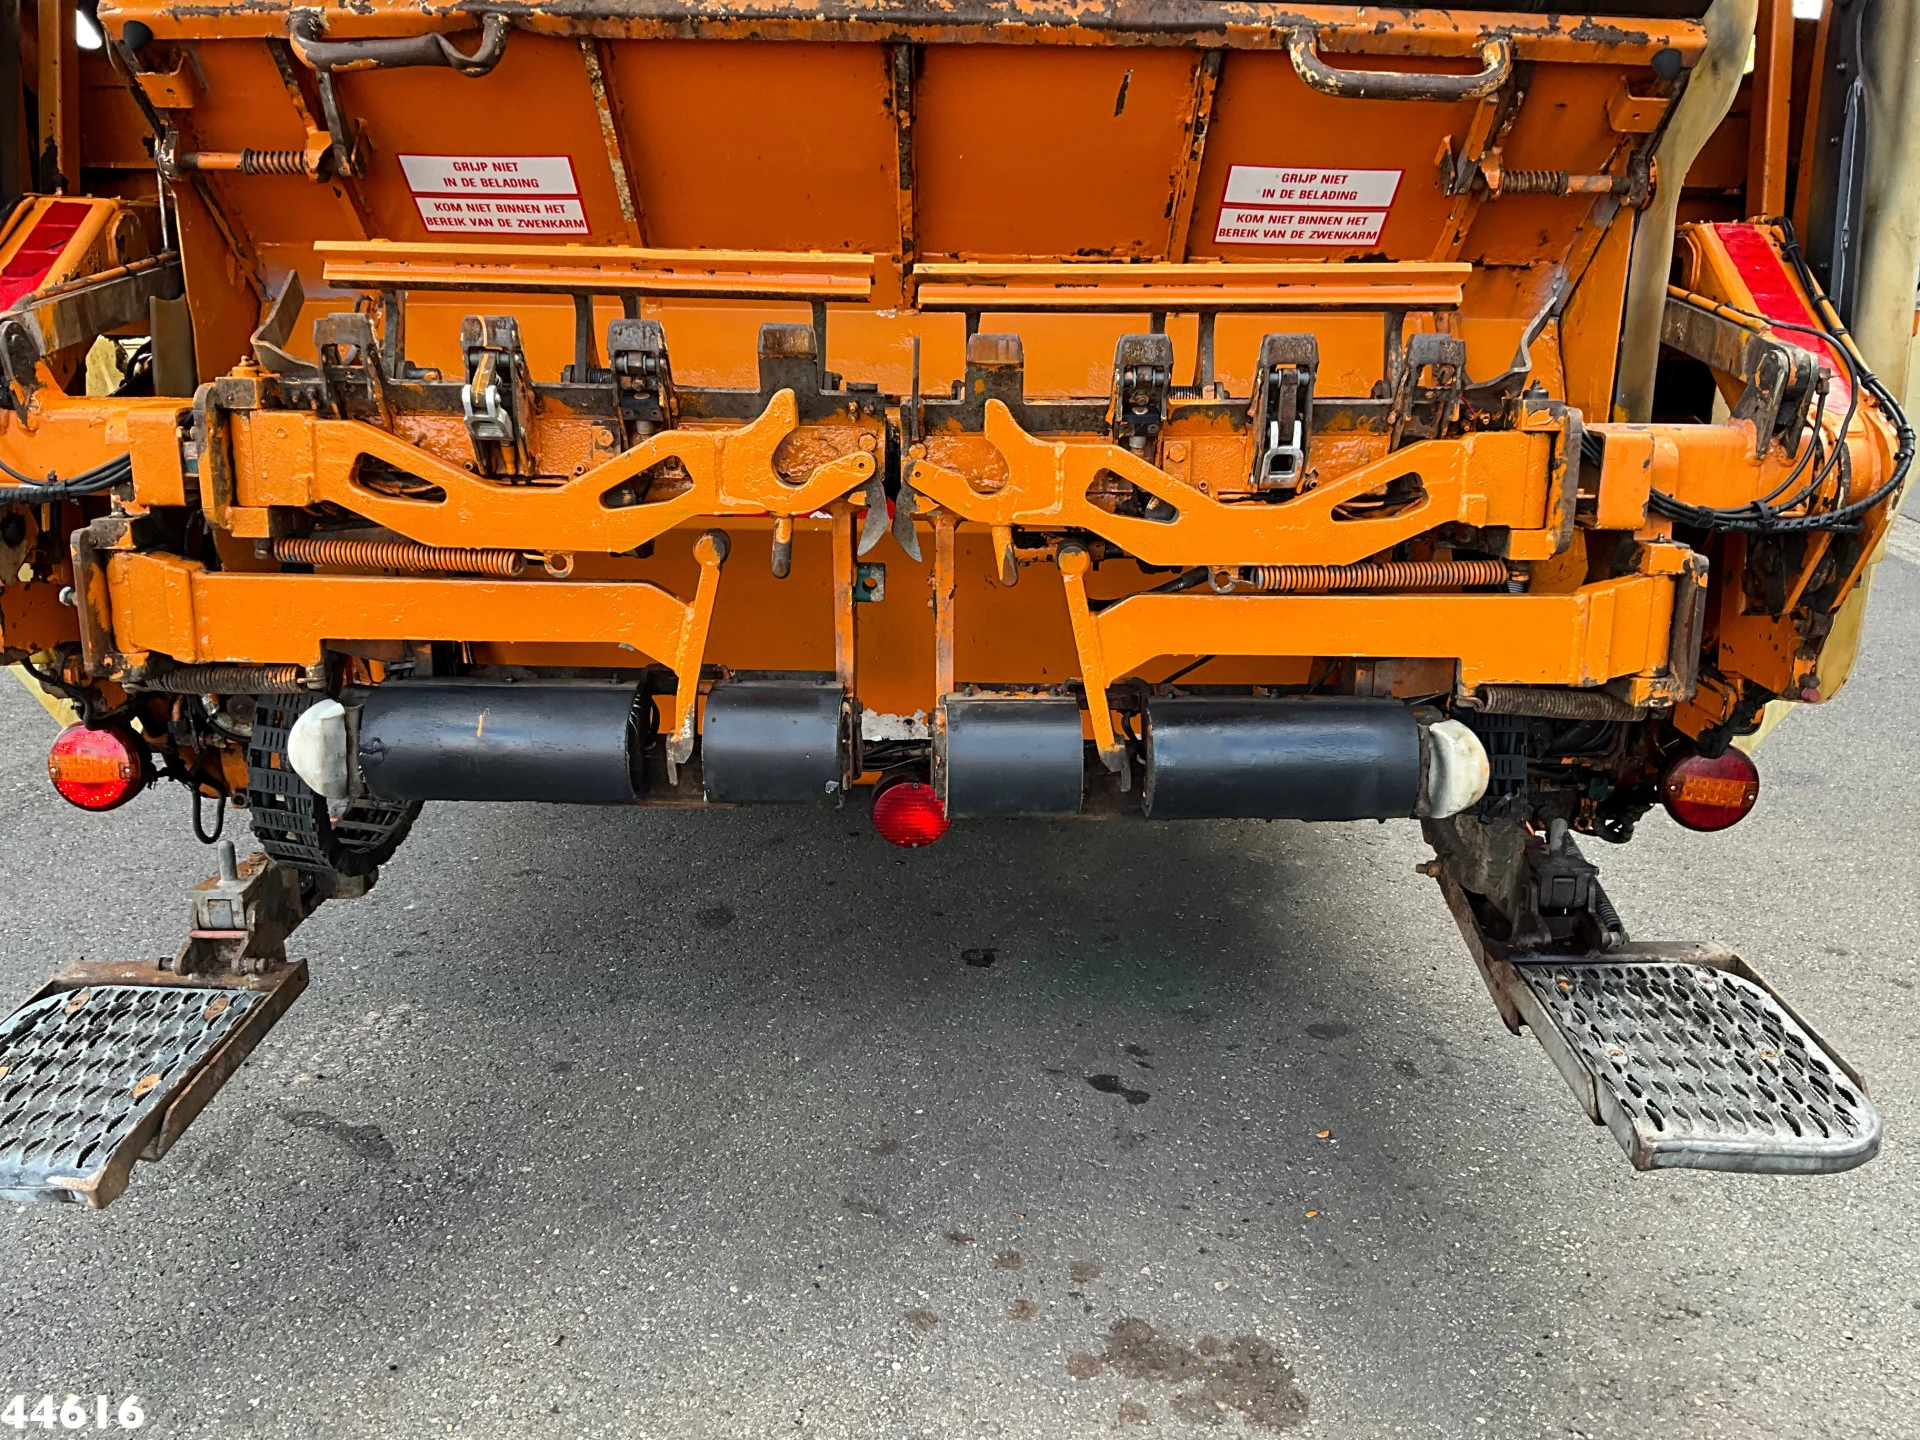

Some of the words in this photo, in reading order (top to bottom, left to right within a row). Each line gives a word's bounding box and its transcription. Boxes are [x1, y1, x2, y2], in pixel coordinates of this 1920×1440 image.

[453, 162, 487, 172] GRIJP
[493, 162, 518, 172] NIET
[443, 178, 457, 187] IN
[461, 178, 476, 187] DE
[480, 178, 539, 188] BELADING
[1282, 174, 1317, 183] GRIJP
[1321, 175, 1348, 184] NIET
[1262, 189, 1275, 198] IN
[1280, 190, 1295, 199] DE
[1299, 190, 1358, 200] BELADING
[434, 203, 462, 212] KOM
[467, 204, 491, 212] NIET
[496, 204, 540, 213] BINNEN
[545, 205, 565, 213] HET
[425, 218, 467, 226] BEREIK
[470, 219, 493, 227] VAN
[497, 219, 513, 227] DE
[517, 219, 585, 228] ZWENKARM
[1236, 214, 1264, 223] KOM
[1268, 215, 1294, 224] NIET
[1298, 216, 1343, 225] BINNEN
[1346, 217, 1369, 226] HET
[1219, 228, 1259, 238] BEREIK
[1263, 230, 1287, 238] VAN
[1290, 231, 1305, 239] DE
[1309, 231, 1377, 240] ZWENKARM
